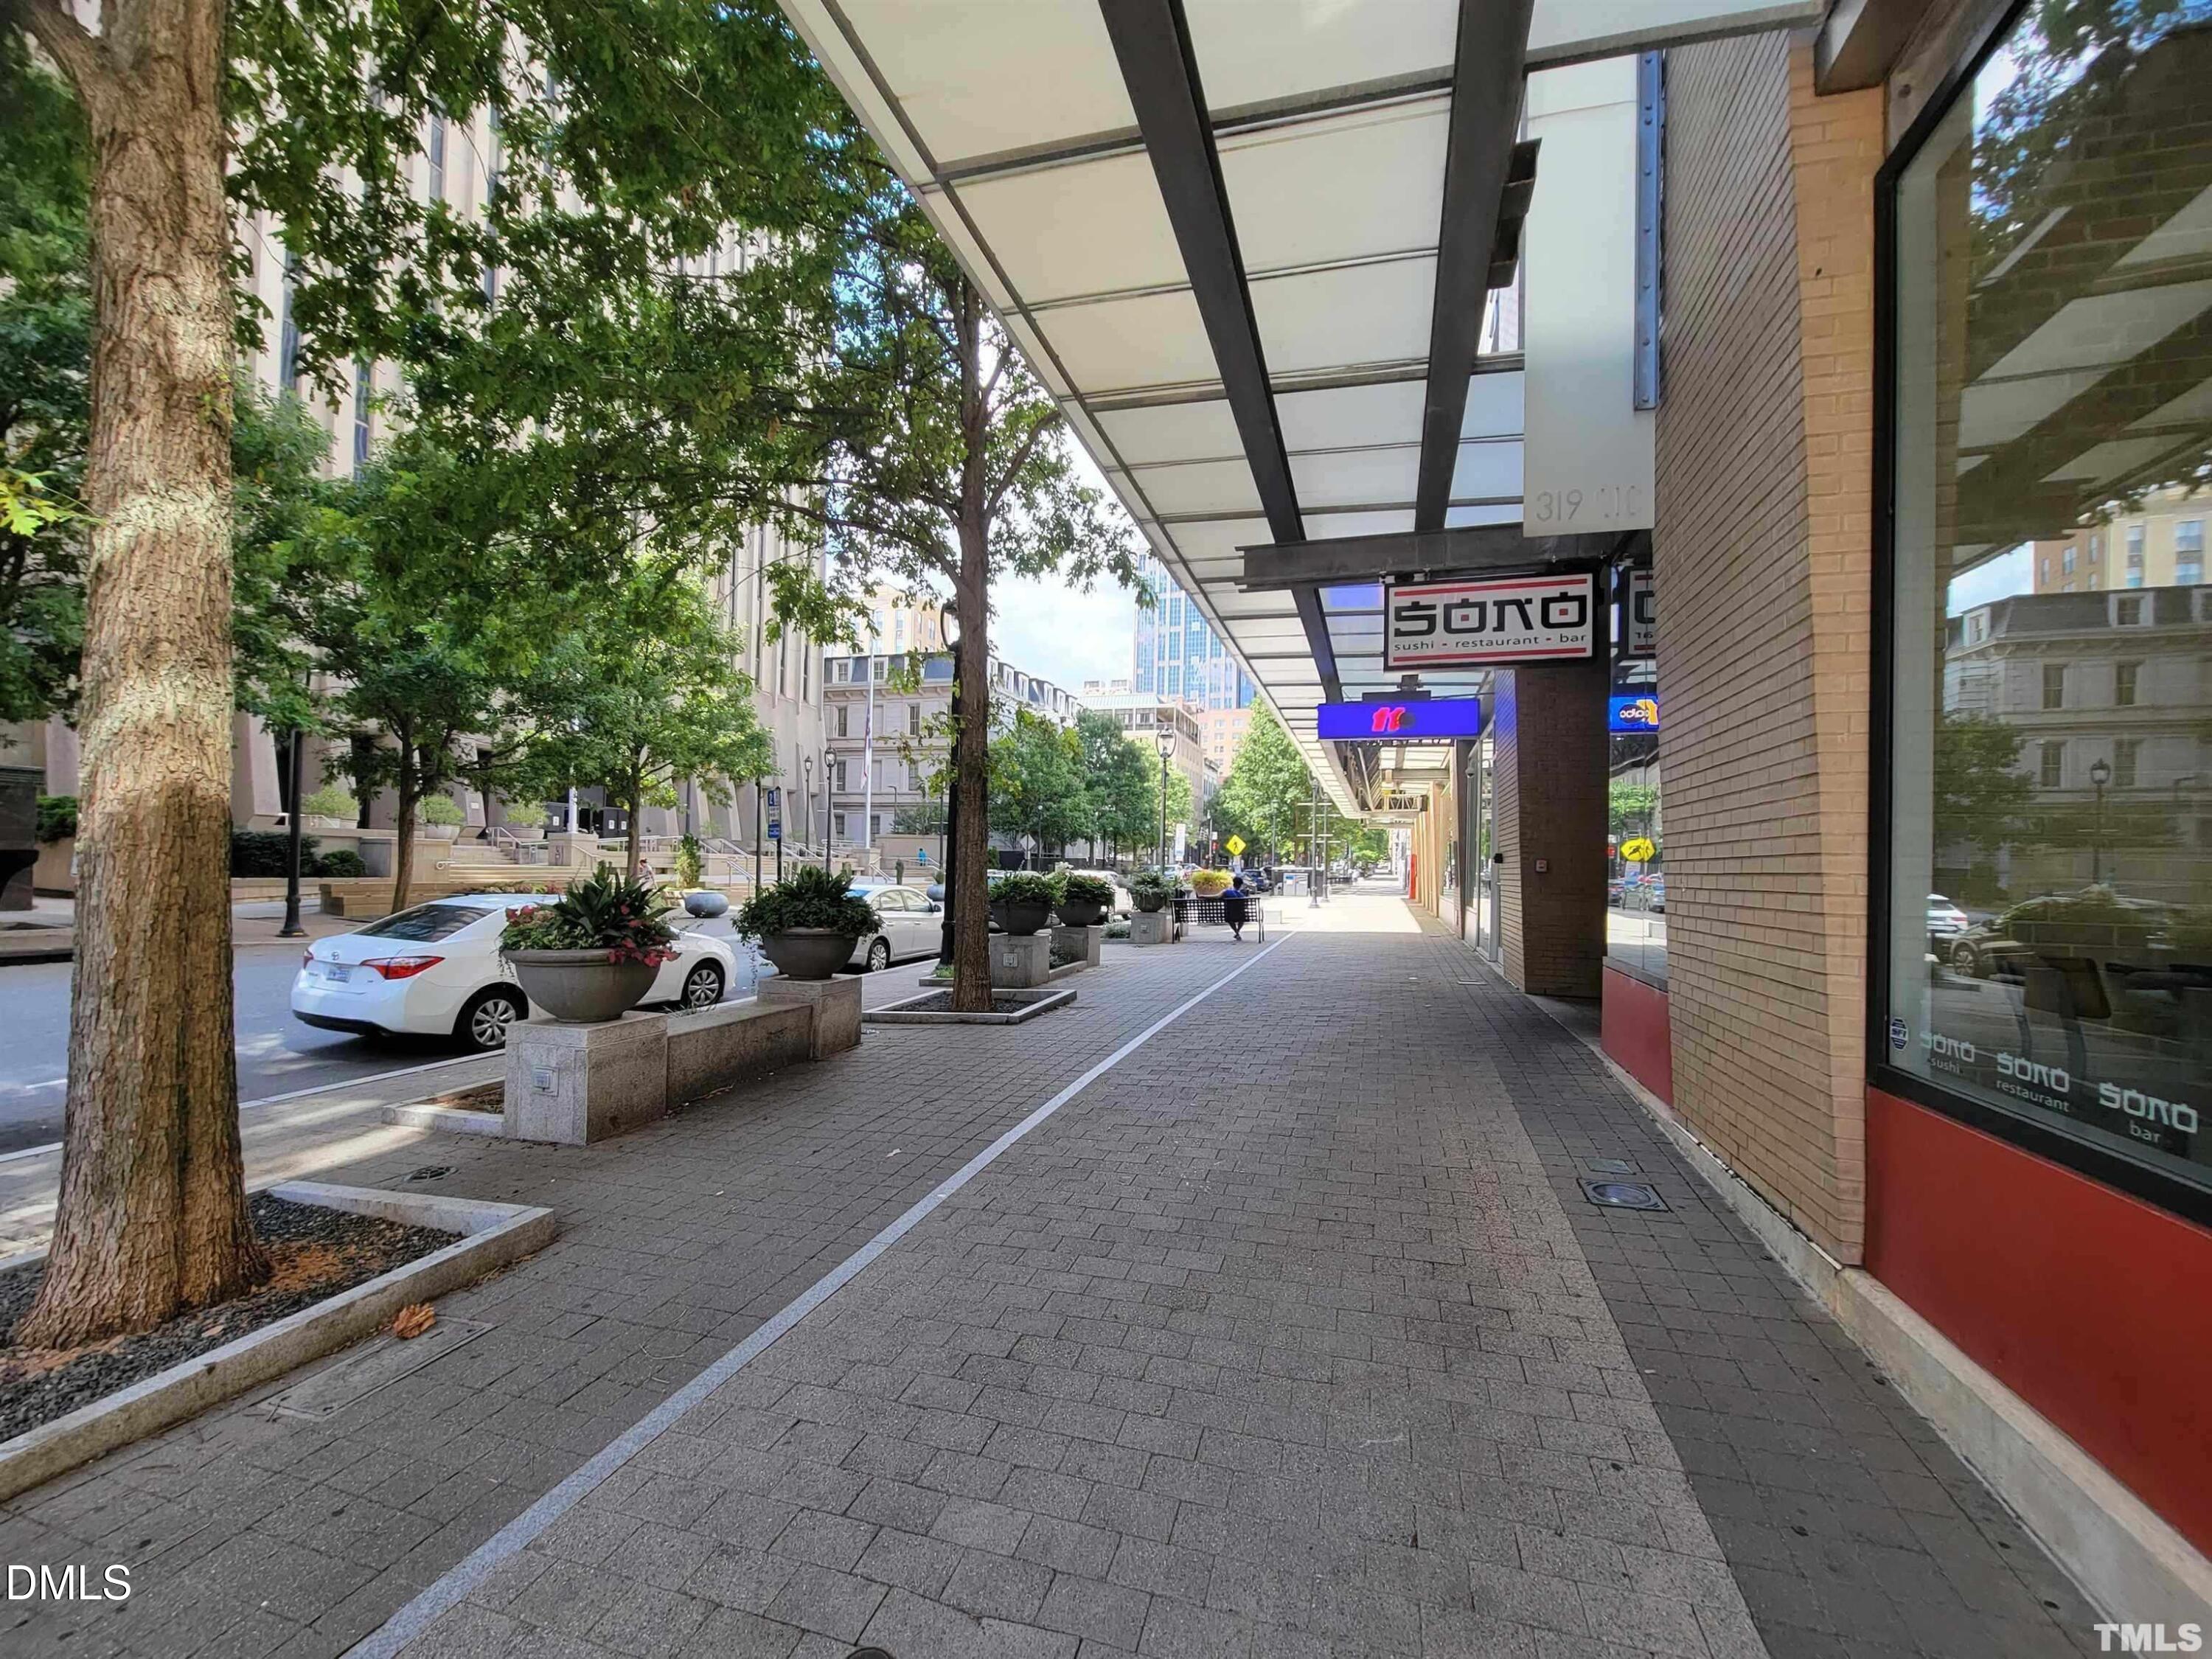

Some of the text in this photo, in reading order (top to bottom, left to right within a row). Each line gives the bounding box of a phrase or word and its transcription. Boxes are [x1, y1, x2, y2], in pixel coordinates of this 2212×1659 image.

[1537, 489, 1583, 521] 319
[1394, 591, 1587, 637] SONO
[1394, 633, 1586, 651] sushi restaurant bar
[1930, 1057, 1961, 1074] sushi
[1997, 1051, 2070, 1093] SONO
[1996, 1079, 2070, 1113] restaurant
[2098, 1081, 2199, 1134] SONO
[2129, 1119, 2161, 1144] bar
